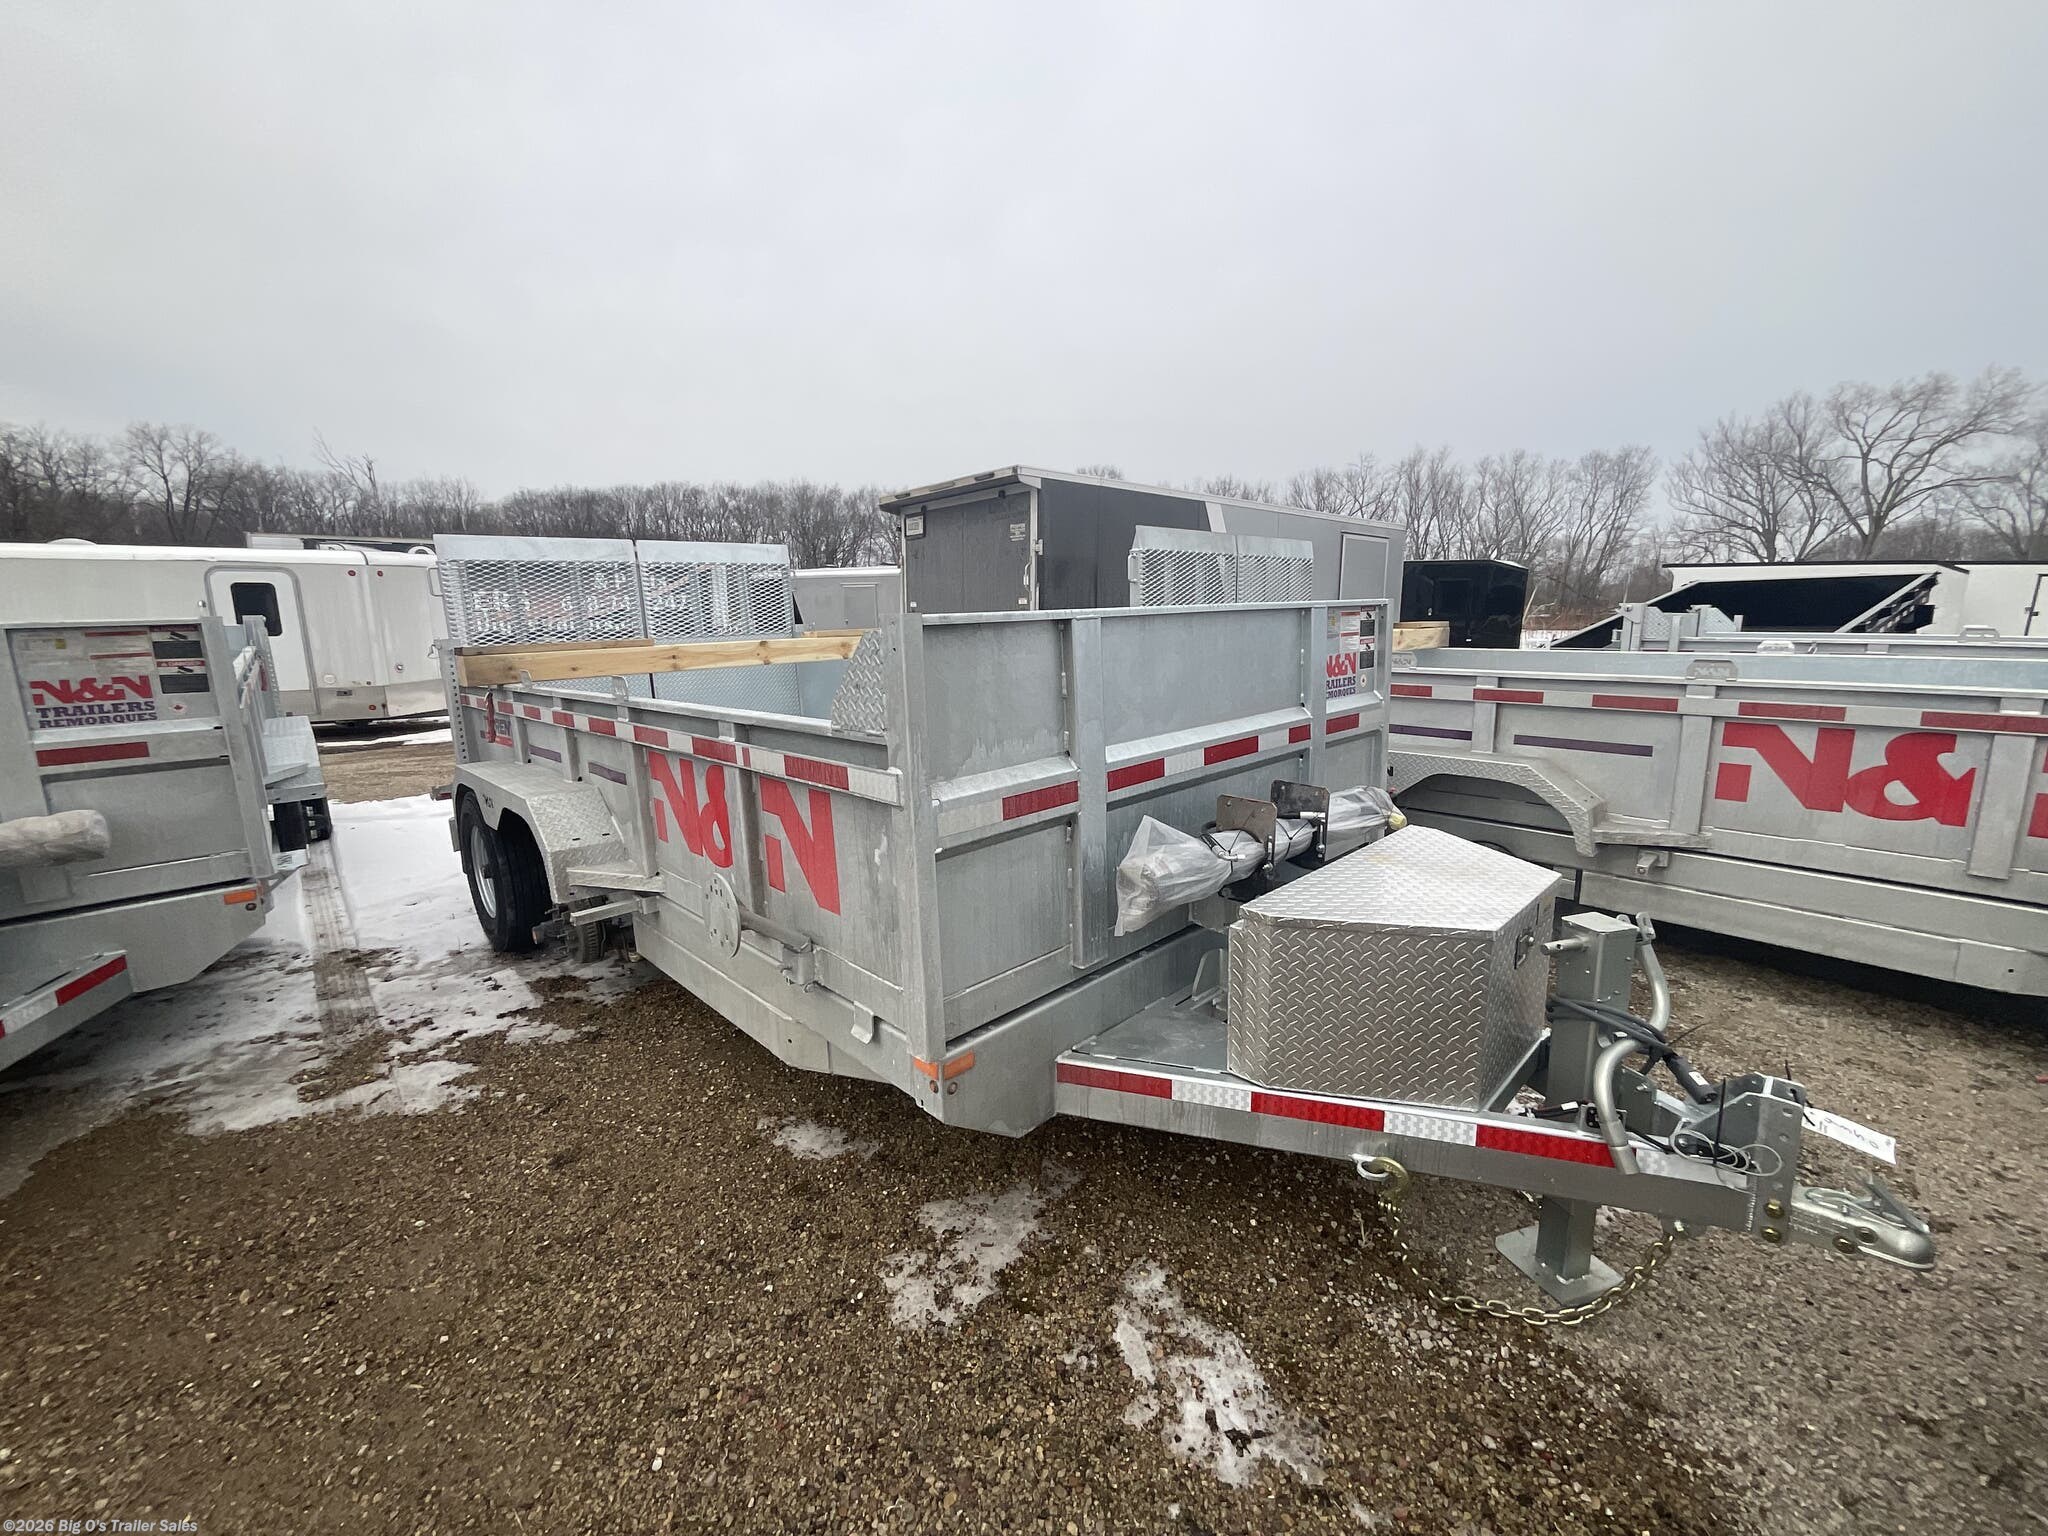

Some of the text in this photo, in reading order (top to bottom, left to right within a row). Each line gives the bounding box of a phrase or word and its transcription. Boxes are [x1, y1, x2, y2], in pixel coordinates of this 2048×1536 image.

[29, 675, 154, 706] N&N
[1326, 676, 1356, 690] RAILERS
[36, 700, 156, 719] TRAILERS
[39, 712, 158, 729] REMORQUES
[1714, 721, 2048, 839] N&
